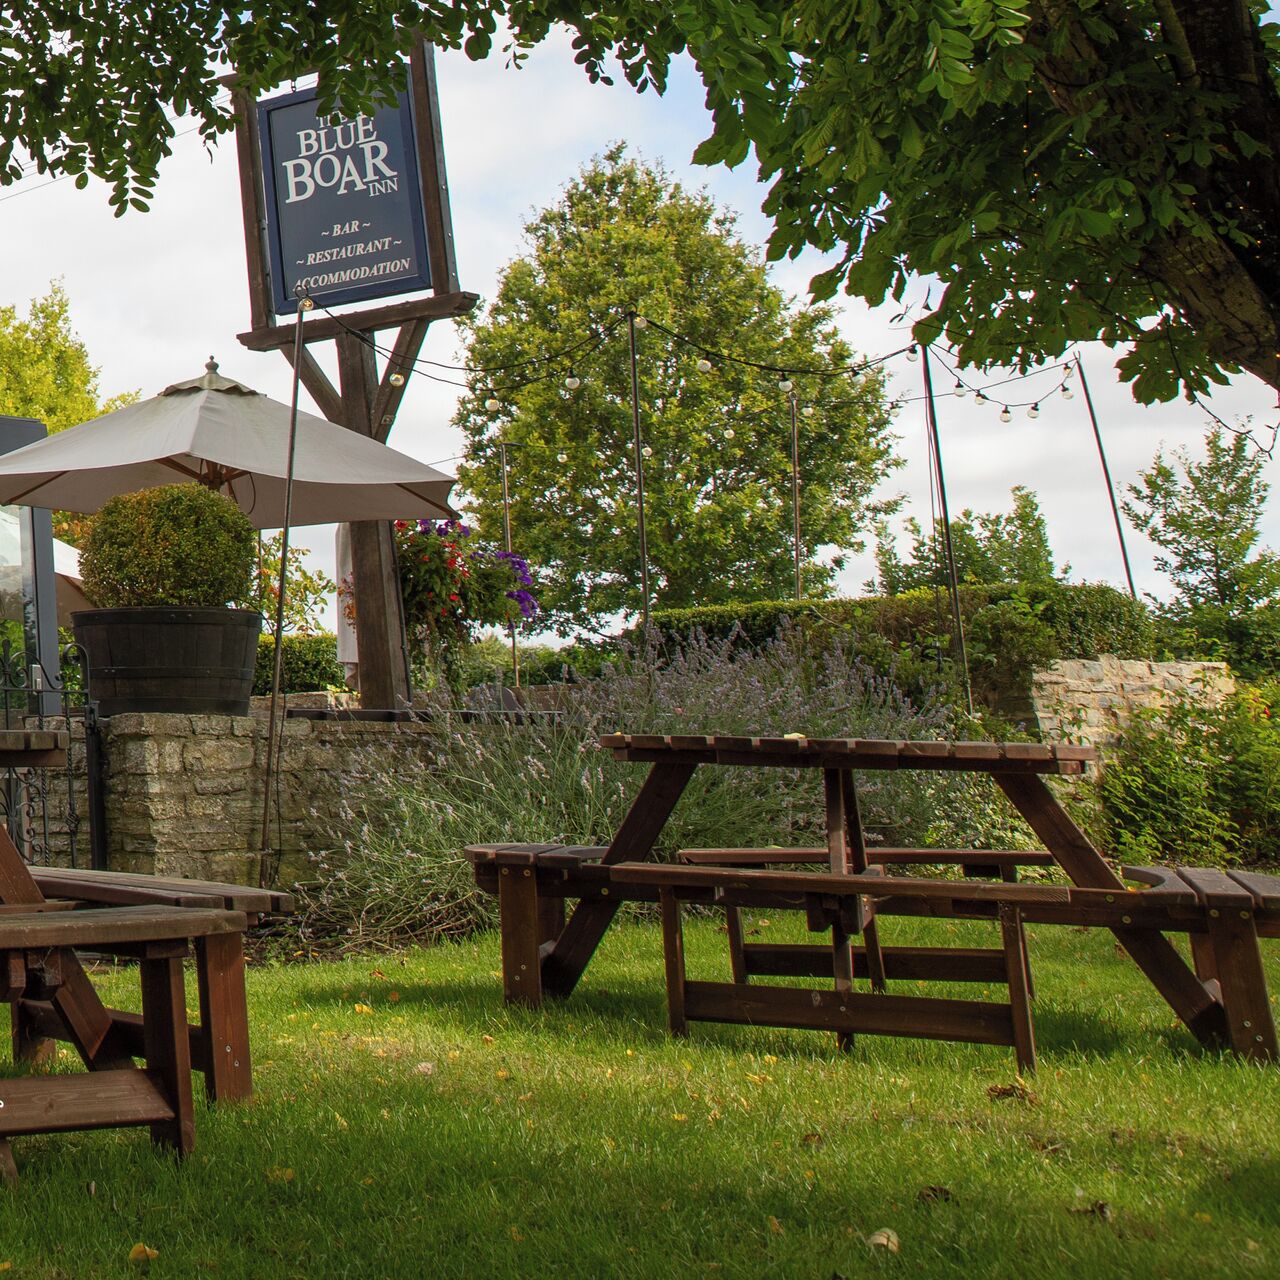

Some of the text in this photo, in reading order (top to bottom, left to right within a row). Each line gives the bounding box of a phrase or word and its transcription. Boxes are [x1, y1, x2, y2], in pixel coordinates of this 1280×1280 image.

[296, 114, 378, 157] BLUE
[282, 140, 397, 204] BOAR
[368, 179, 399, 197] INN
[332, 220, 360, 237] BAR
[307, 238, 392, 266] RESTAURANT
[293, 257, 411, 291] ACCOMMODATION
